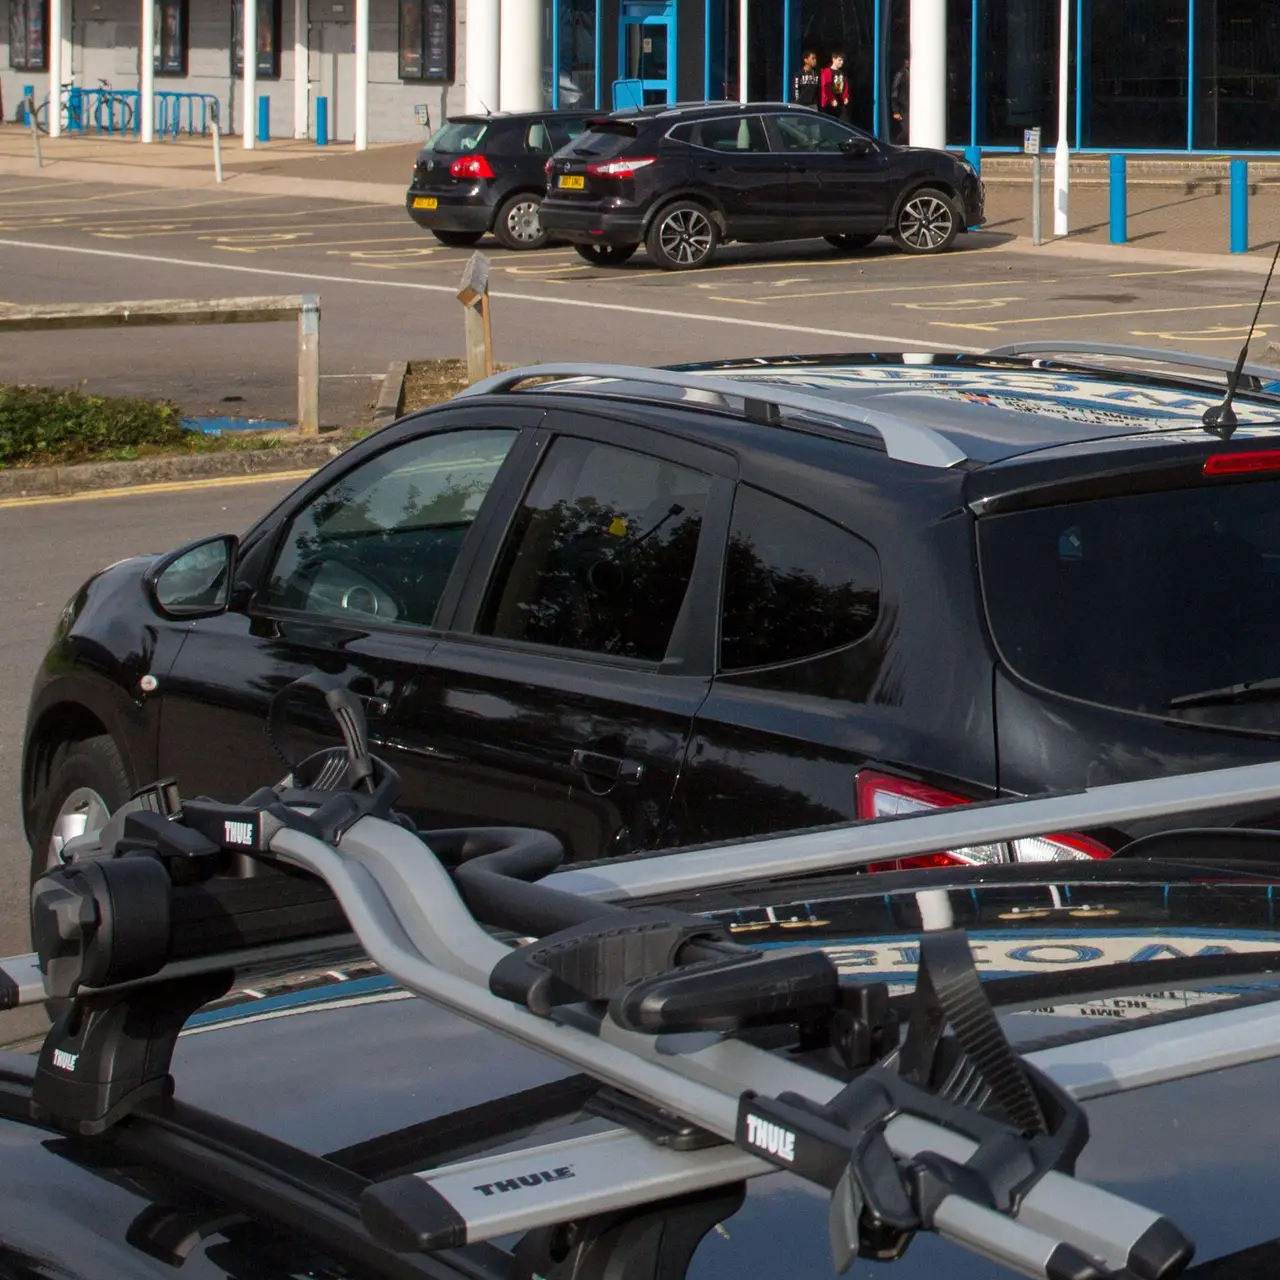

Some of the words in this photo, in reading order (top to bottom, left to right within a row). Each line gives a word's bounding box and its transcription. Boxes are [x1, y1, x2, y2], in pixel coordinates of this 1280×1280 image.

[224, 820, 253, 845] THULE
[53, 1049, 78, 1071] THULE
[747, 1114, 796, 1162] THULE
[473, 1166, 576, 1197] THULE
